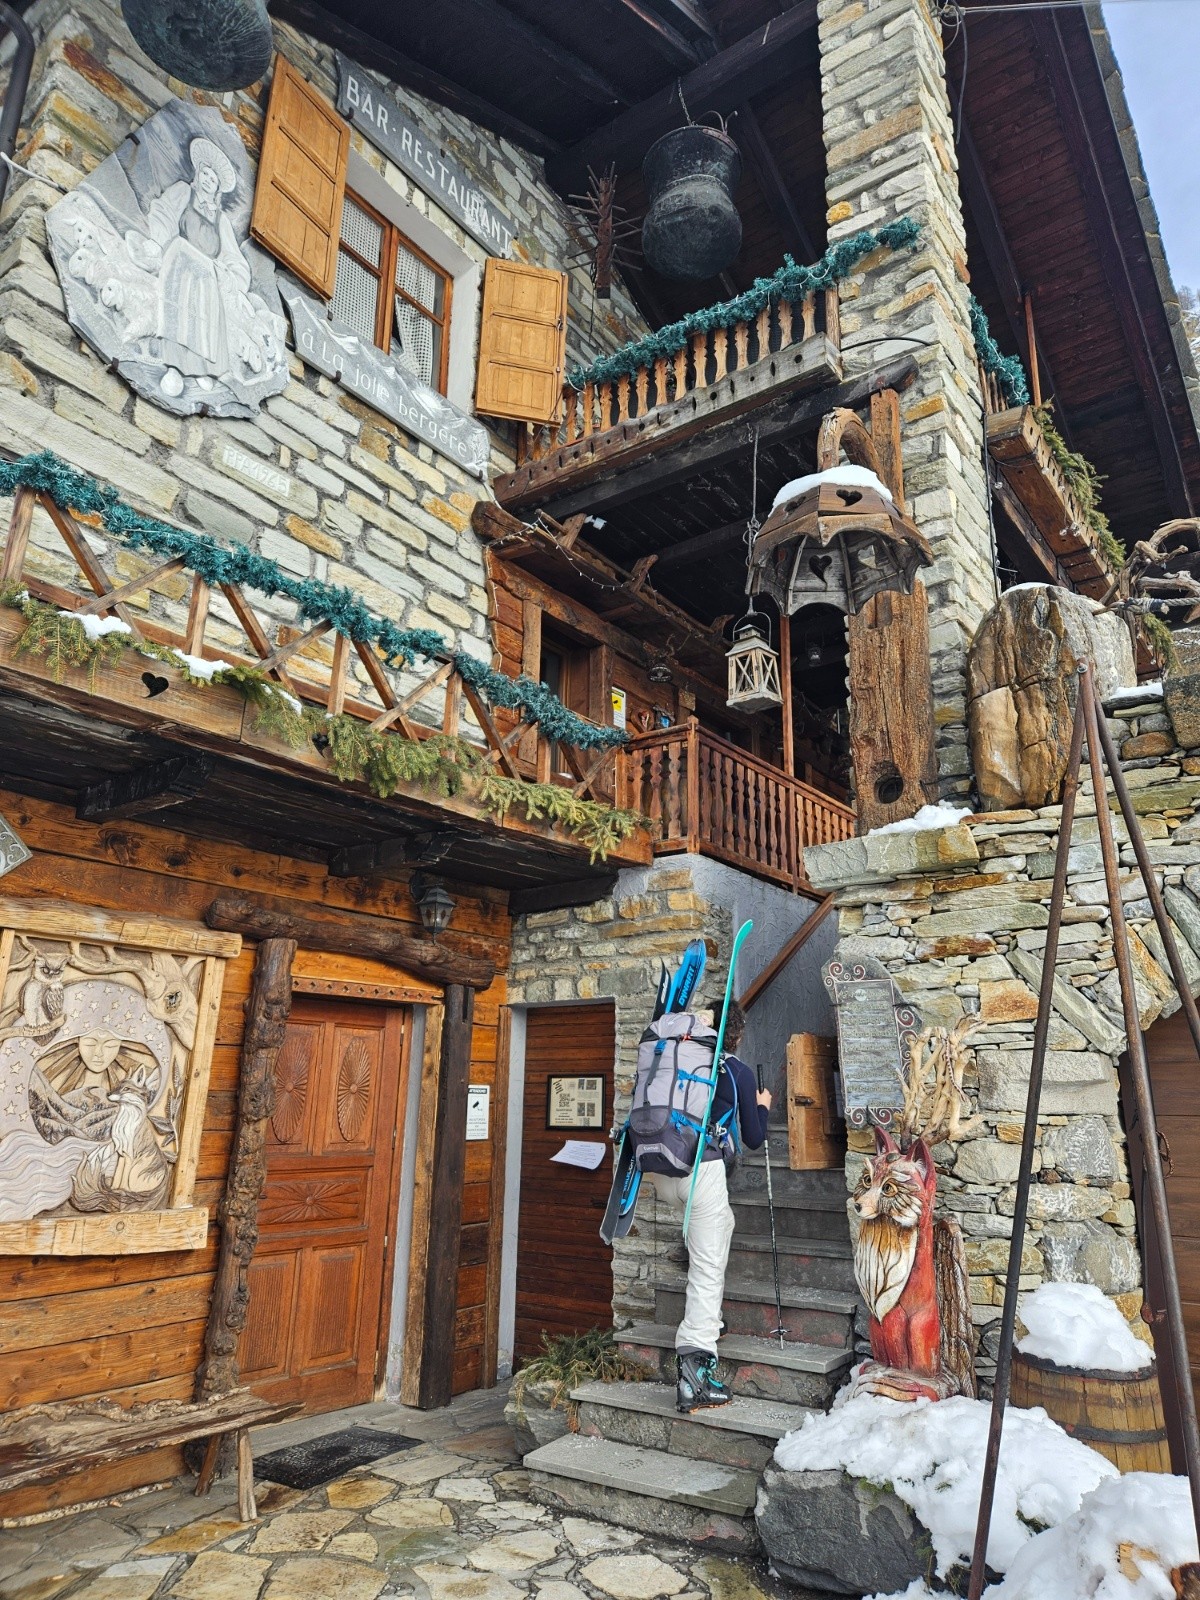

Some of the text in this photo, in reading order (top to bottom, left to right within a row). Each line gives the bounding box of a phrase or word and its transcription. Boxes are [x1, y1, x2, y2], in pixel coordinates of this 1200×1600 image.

[346, 74, 511, 251] BAR RESTAURANT
[352, 363, 390, 403] jolie
[399, 395, 468, 458] bergère
[679, 966, 695, 1006] DYNAFIT
